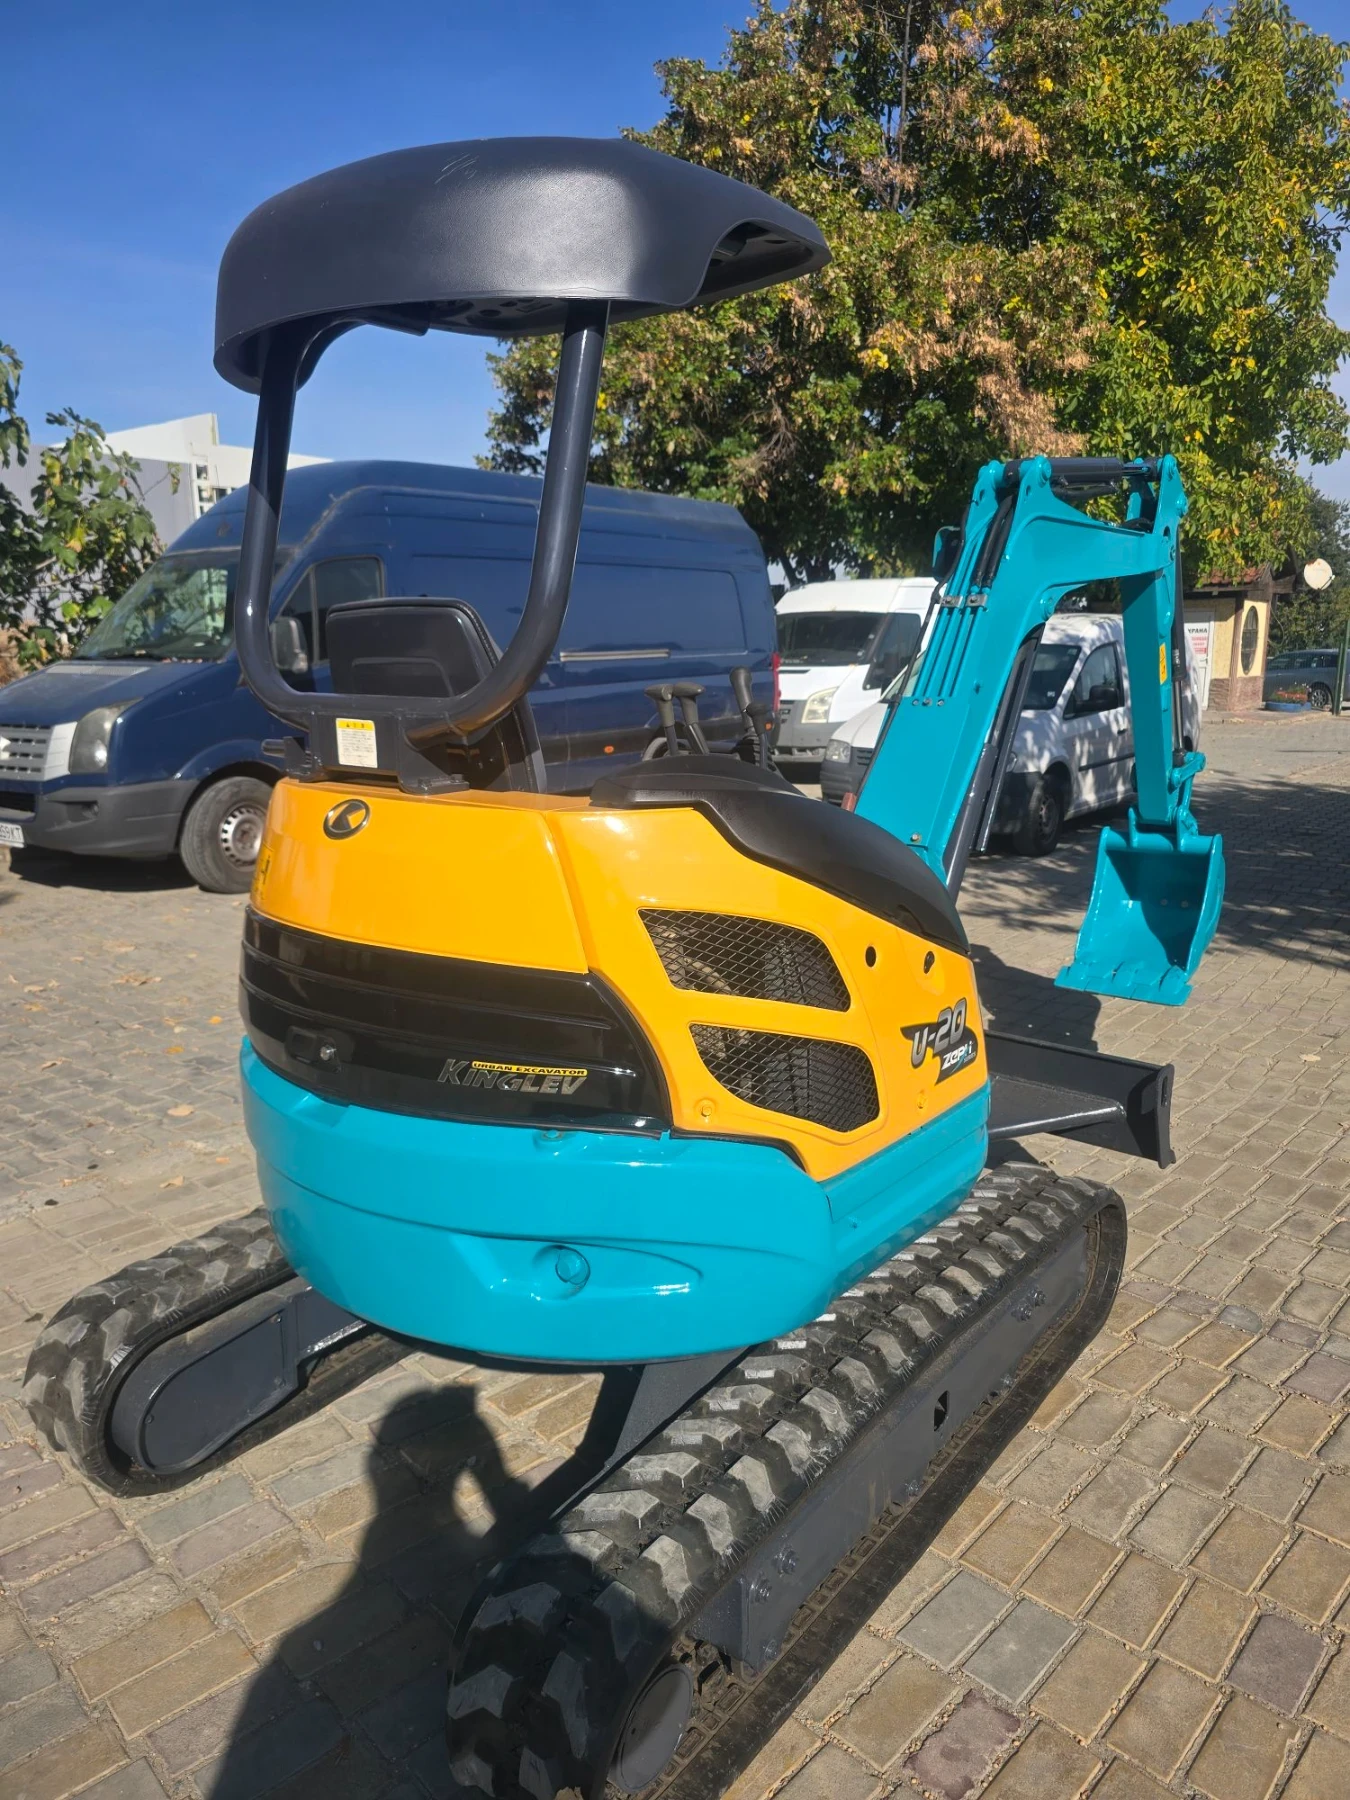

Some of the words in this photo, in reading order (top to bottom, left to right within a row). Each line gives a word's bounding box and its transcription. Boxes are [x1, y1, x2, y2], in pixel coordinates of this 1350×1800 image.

[911, 997, 967, 1069] U-20
[437, 1058, 587, 1095] KINGLEV
[474, 1062, 512, 1071] URBAN
[518, 1066, 586, 1076] EXCAVATOR
